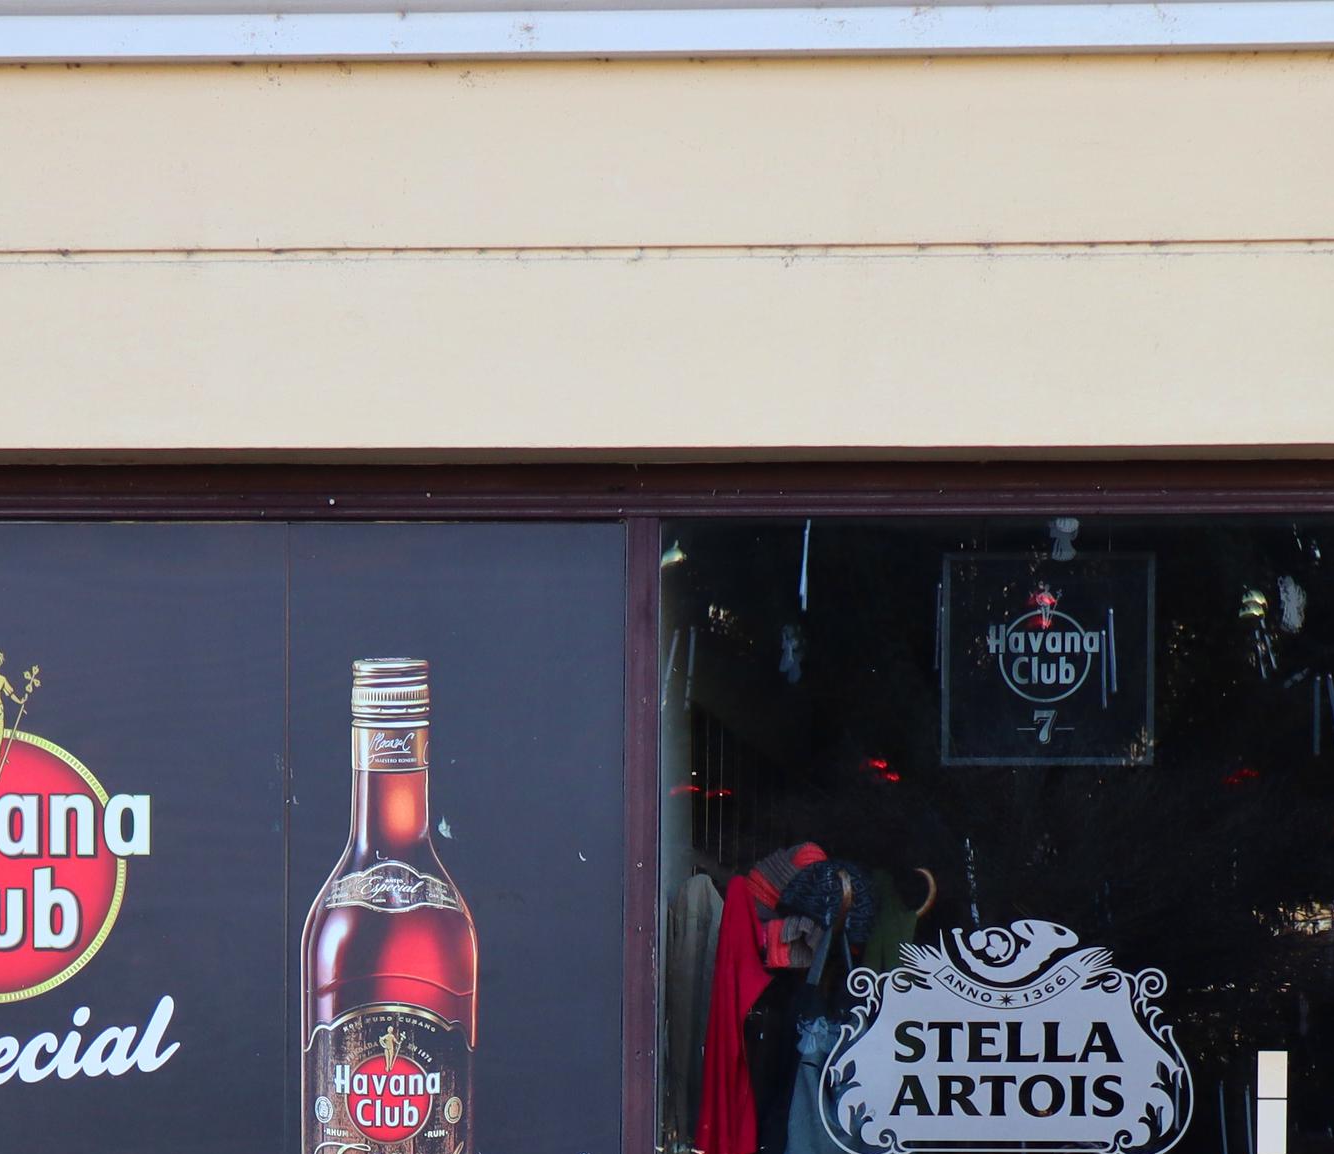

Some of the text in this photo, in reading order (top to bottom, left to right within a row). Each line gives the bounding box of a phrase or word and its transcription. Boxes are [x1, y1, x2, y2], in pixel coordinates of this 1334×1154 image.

[987, 624, 1099, 653] Havana
[1012, 656, 1075, 684] Club
[1033, 709, 1057, 744] 7
[356, 876, 424, 900] Especial
[942, 973, 1068, 1003] ANNO 1366
[894, 1020, 1124, 1063] STELLA
[335, 1065, 441, 1095] Havana
[889, 1074, 1125, 1118] ARTOIS
[356, 1099, 418, 1127] Club
